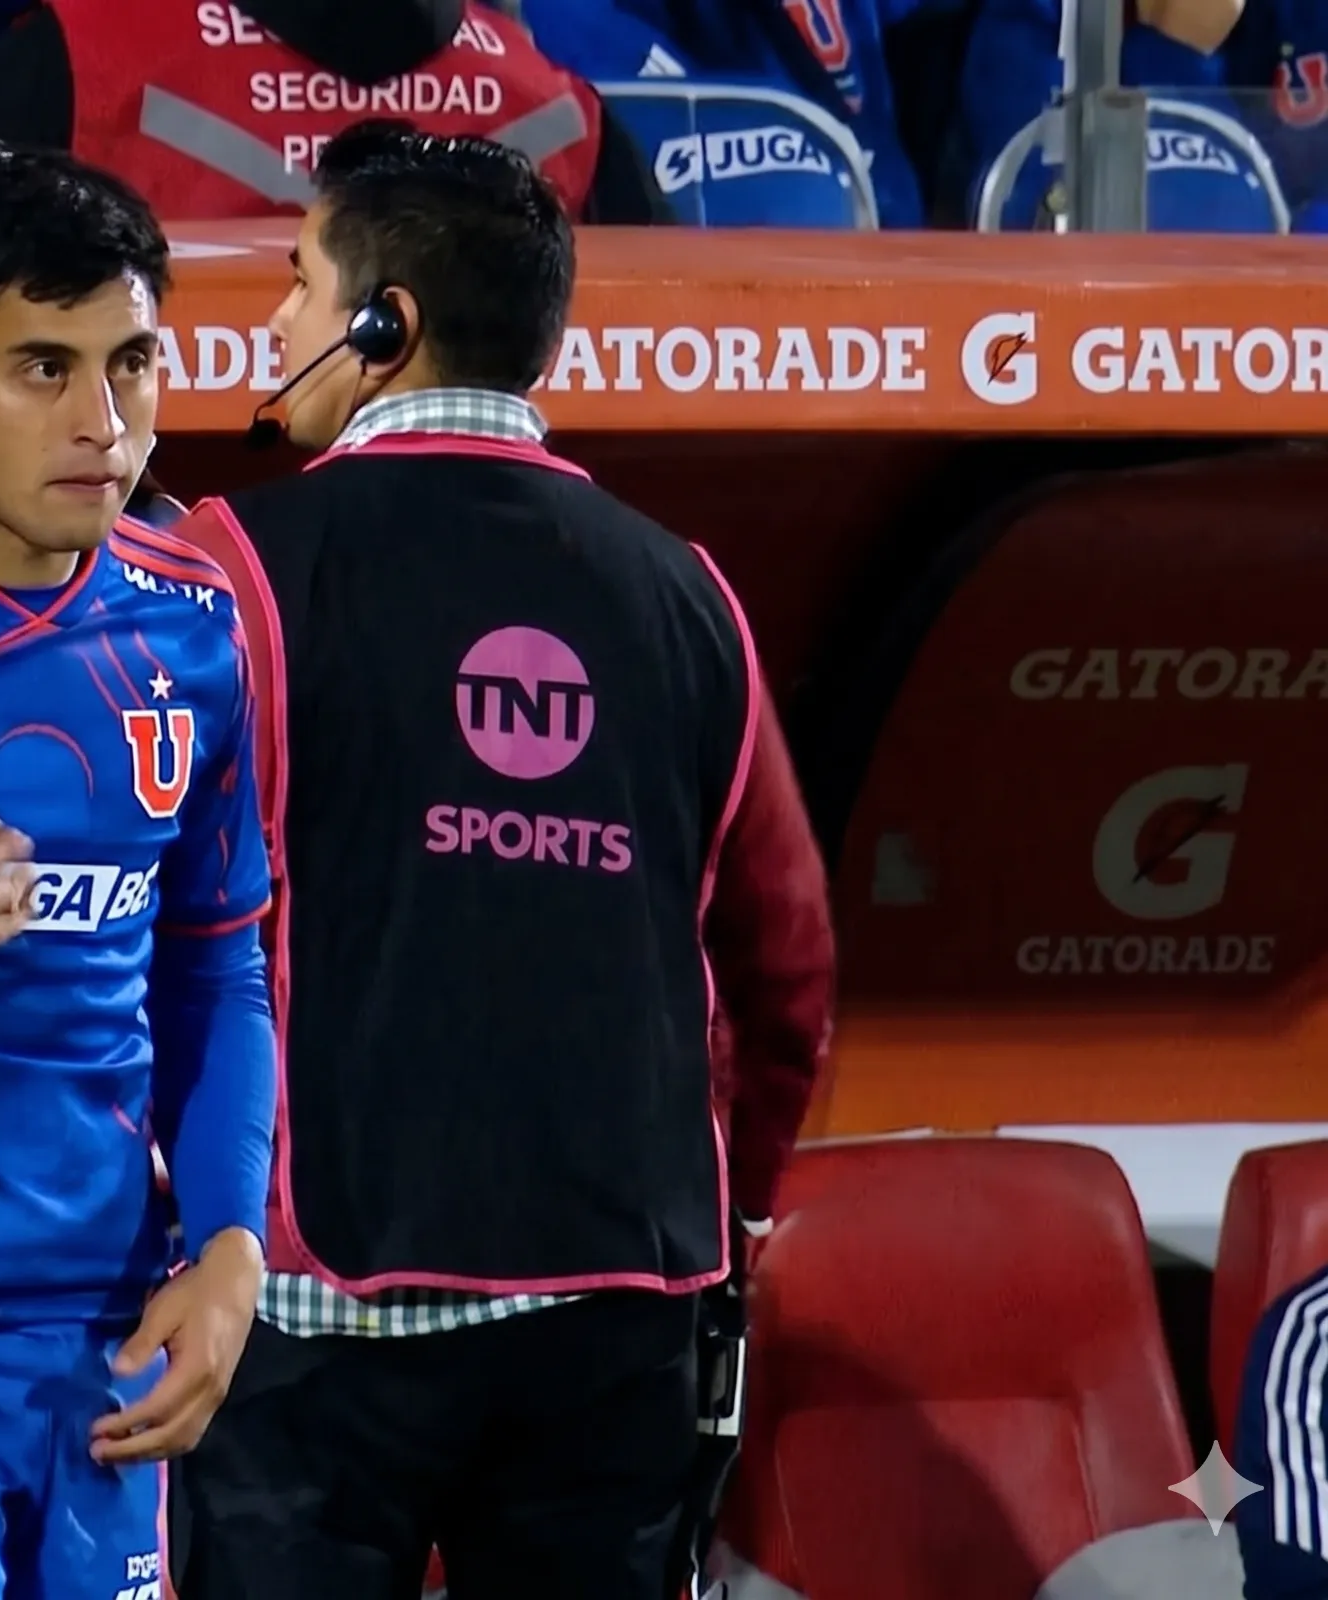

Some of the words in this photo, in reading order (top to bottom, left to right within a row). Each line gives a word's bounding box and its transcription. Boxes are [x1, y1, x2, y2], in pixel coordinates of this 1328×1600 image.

[250, 71, 502, 114] SEGURIDAD
[715, 133, 822, 172] JUGA
[529, 327, 925, 391] ATORADE
[961, 312, 1037, 404] G
[457, 672, 590, 742] TNT
[1009, 647, 1328, 699] GATORA
[122, 708, 194, 818] U
[425, 804, 632, 872] SPORTS
[1092, 763, 1250, 920] G
[1016, 936, 1275, 974] GATORADE
